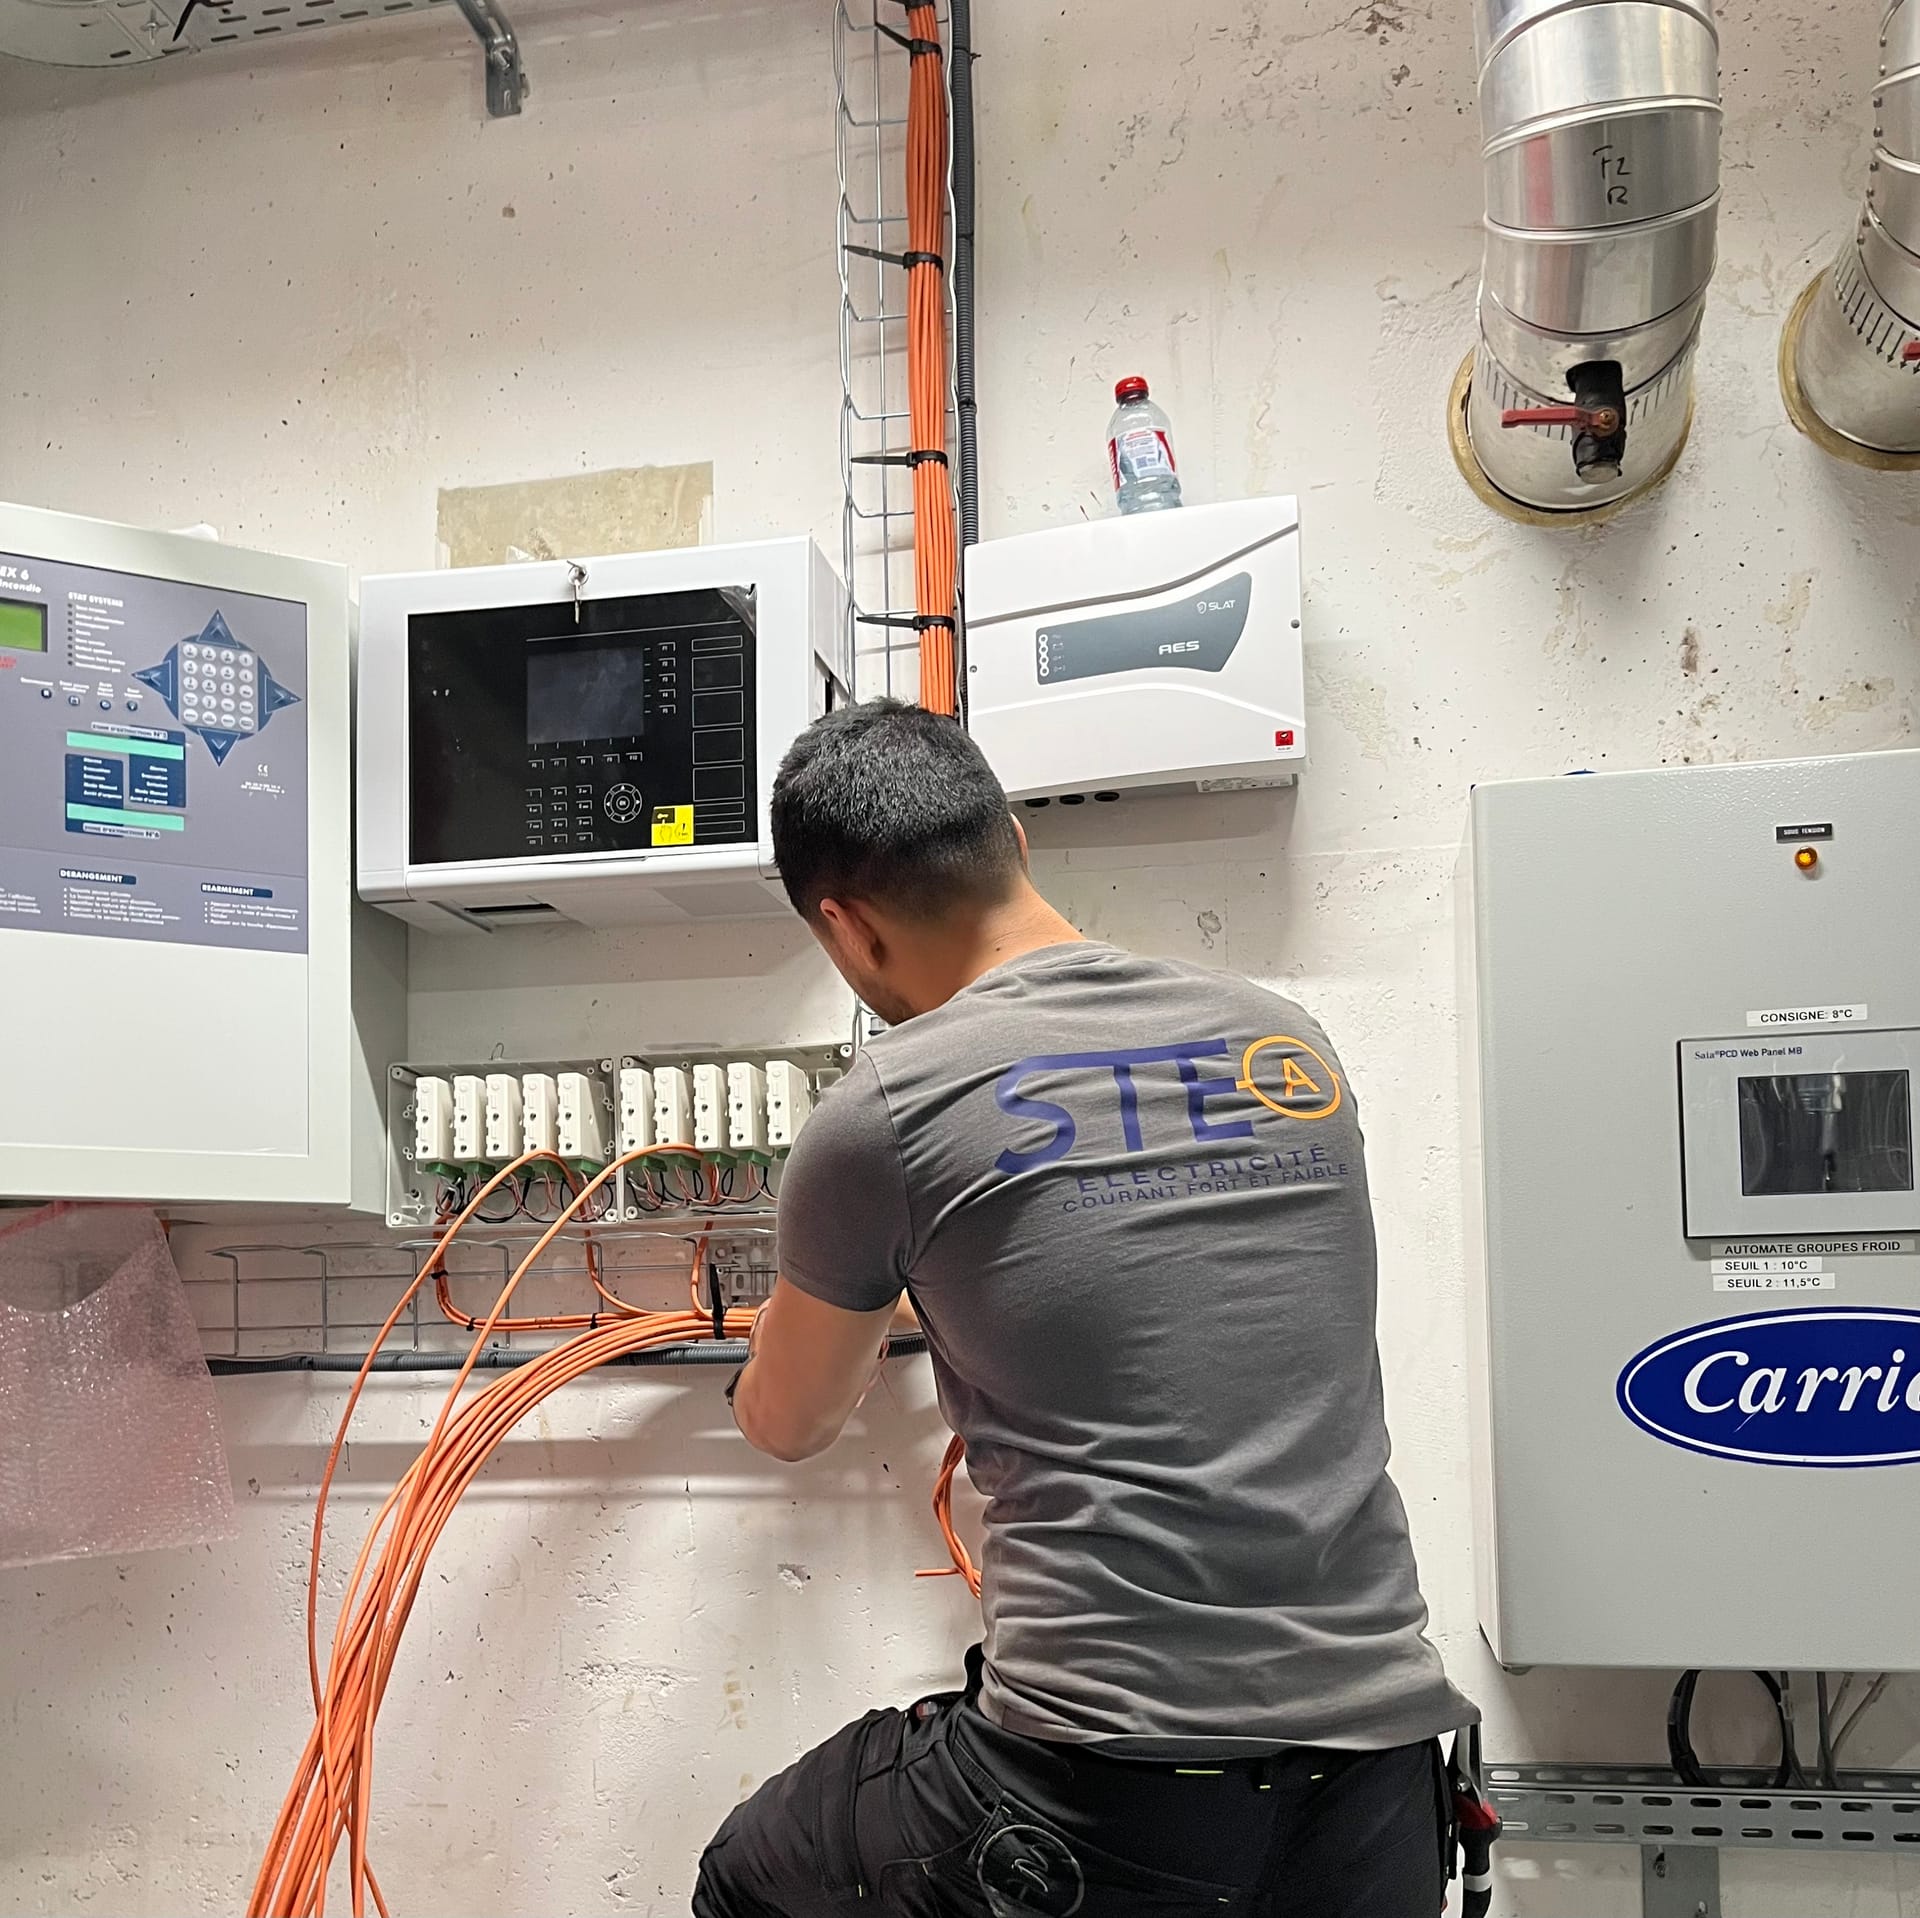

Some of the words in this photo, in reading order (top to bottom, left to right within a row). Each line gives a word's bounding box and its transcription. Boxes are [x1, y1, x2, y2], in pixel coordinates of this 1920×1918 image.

[1208, 600, 1236, 611] SLAT
[1158, 640, 1200, 655] AES
[60, 869, 123, 883] DERANGEMENT
[201, 884, 254, 896] REARMEMENT
[1760, 1010, 1829, 1023] CONSIGNE:
[1740, 1048, 1759, 1057] Web
[1761, 1047, 1786, 1057] Panel
[994, 1037, 1254, 1175] STE
[1062, 1185, 1176, 1213] COURANT
[1187, 1179, 1237, 1195] FORT
[1250, 1174, 1271, 1188] ET
[1283, 1163, 1349, 1184] FAIBLE
[1724, 1243, 1793, 1255] AUTOMATE
[1796, 1242, 1858, 1253] GROUPES
[1862, 1241, 1900, 1252] FROID
[1724, 1260, 1759, 1271] SEUIL
[1781, 1260, 1808, 1270] 10°C
[1727, 1279, 1762, 1289] SEUIL
[1765, 1279, 1772, 1288] 2
[1783, 1277, 1821, 1288] 11,5°C
